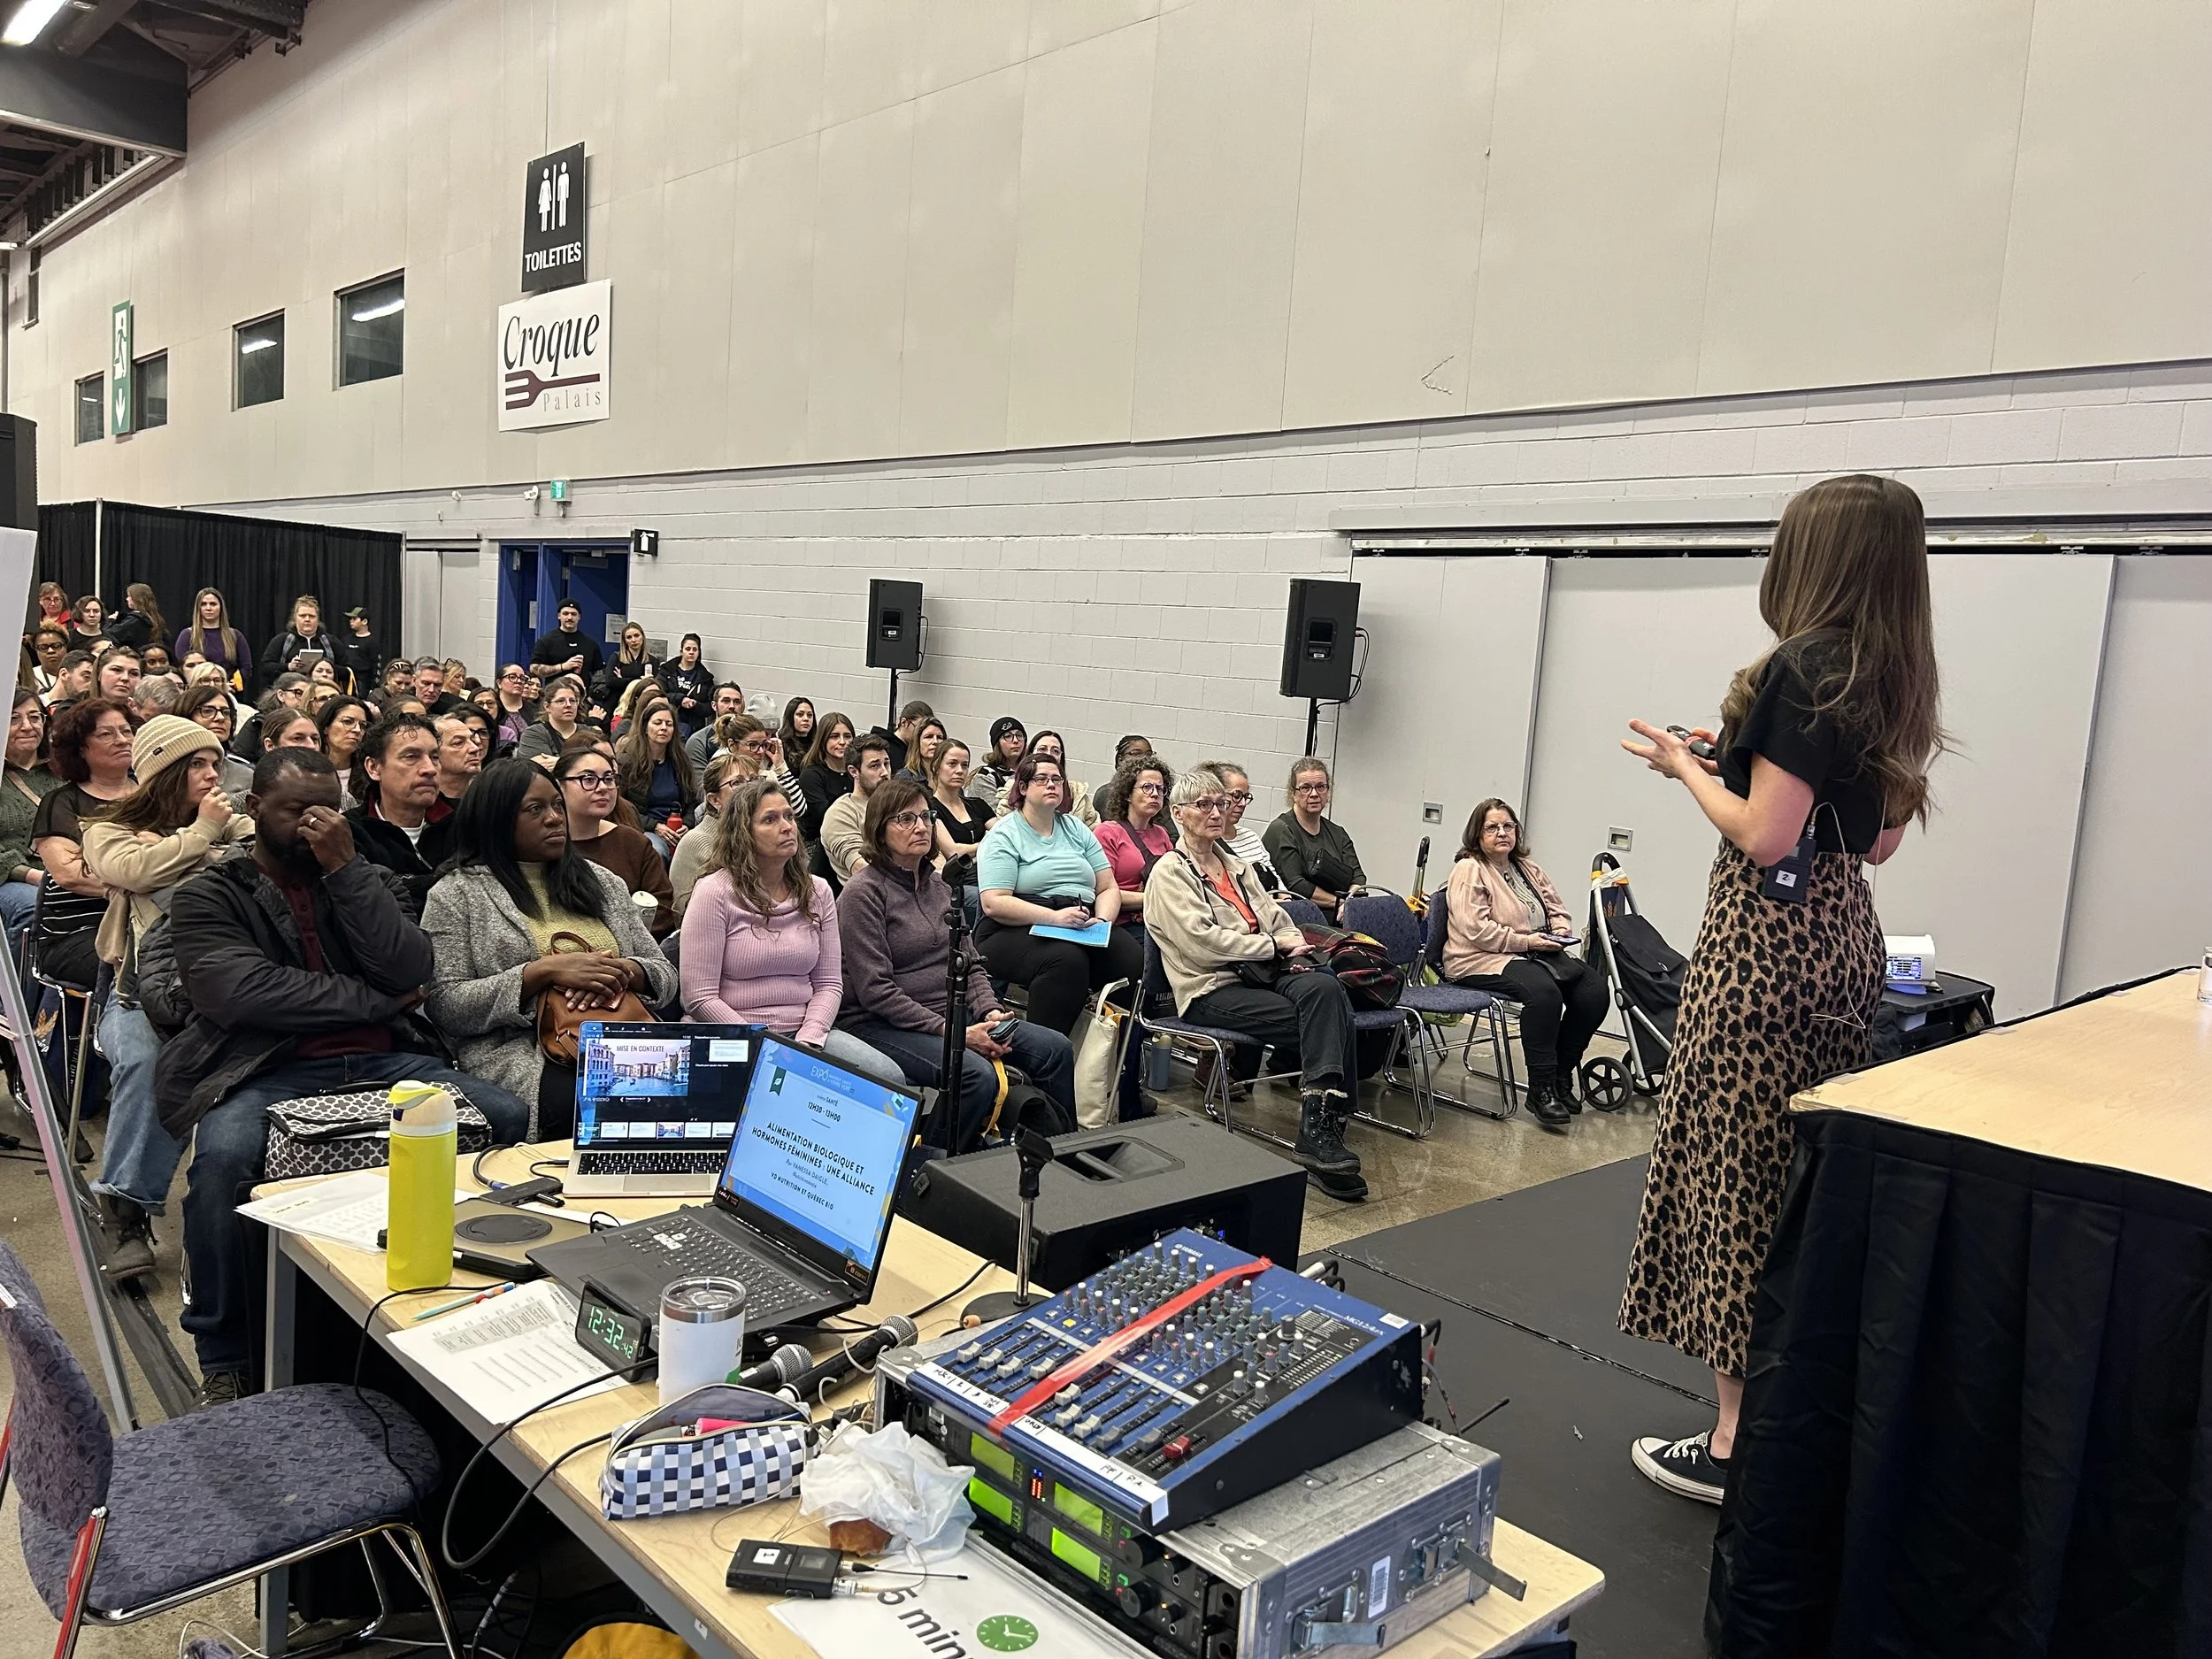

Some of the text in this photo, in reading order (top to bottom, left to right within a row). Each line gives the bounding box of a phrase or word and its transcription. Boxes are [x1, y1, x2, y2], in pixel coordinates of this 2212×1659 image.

[525, 241, 582, 273] TOILETTES
[503, 313, 600, 378] Croque
[542, 390, 601, 412] Palais
[807, 1101, 823, 1114] 12H30
[825, 1110, 841, 1123] 13H00
[752, 1126, 787, 1150] HORMONES
[787, 1144, 822, 1169] FÉMININES
[826, 1164, 841, 1179] UNE
[841, 1172, 875, 1195] ALLIANCE
[766, 1121, 864, 1175] ALIMENTATION BIOLOGIQUE ET
[792, 1162, 811, 1177] VANESSA
[777, 1174, 802, 1193] NUTRITION
[825, 1200, 834, 1210] BIO
[588, 1305, 625, 1351] 12:32
[877, 1586, 918, 1606] 5
